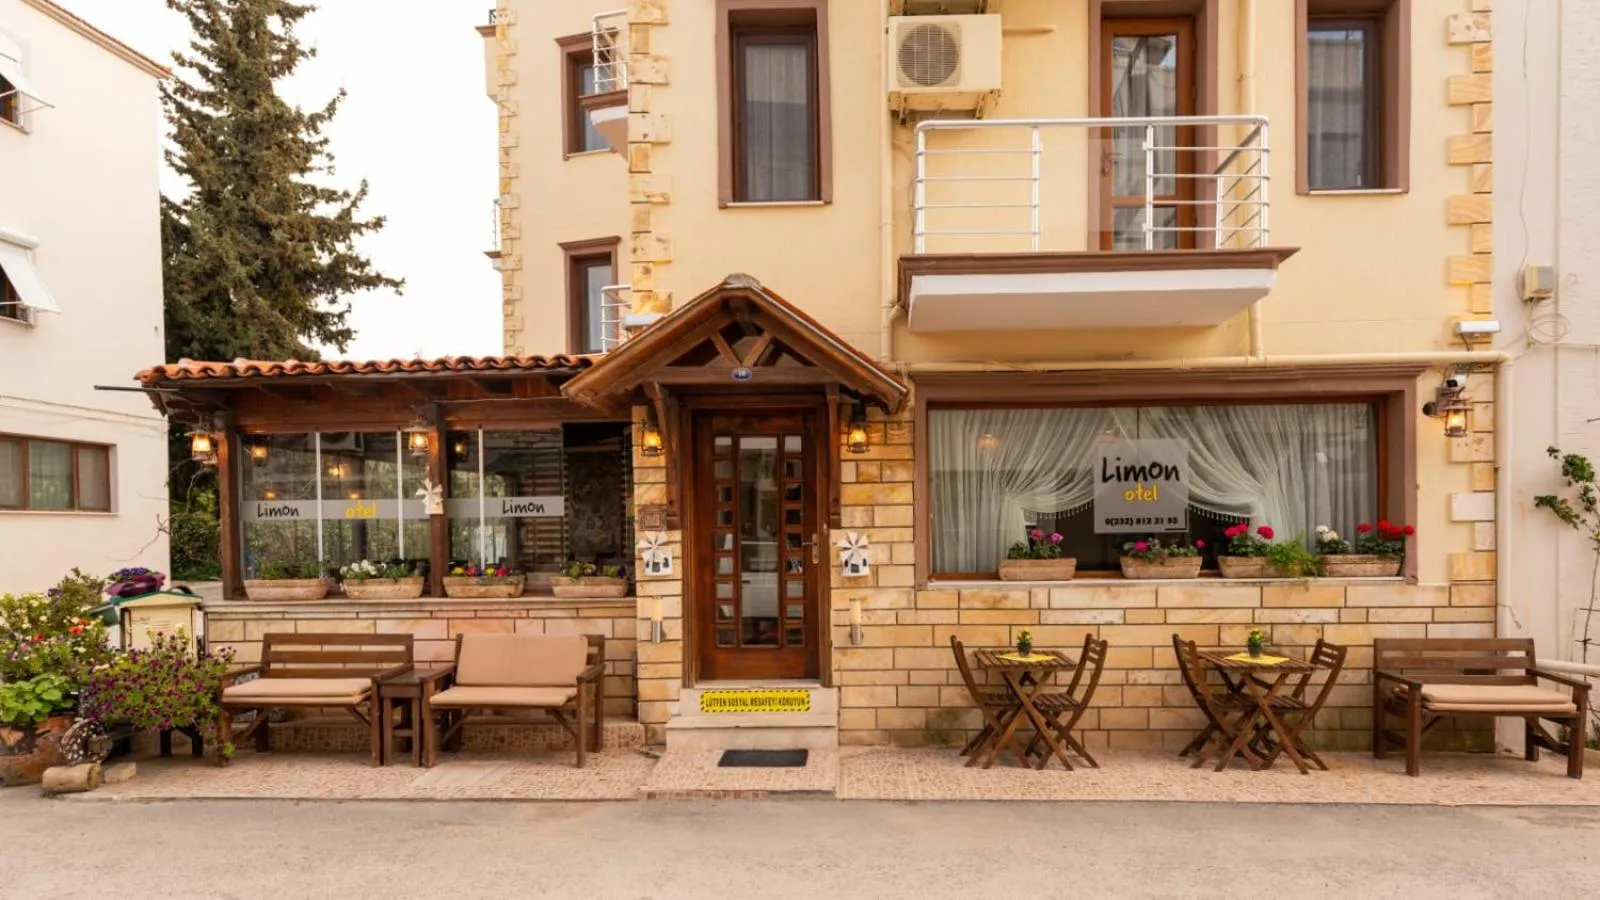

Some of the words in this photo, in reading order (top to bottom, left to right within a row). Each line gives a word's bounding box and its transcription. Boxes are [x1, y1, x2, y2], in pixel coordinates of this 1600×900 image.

[1102, 456, 1180, 483] Limon
[1124, 480, 1159, 502] otel
[257, 503, 299, 518] Limon
[345, 500, 377, 518] otel
[502, 501, 545, 515] Limon
